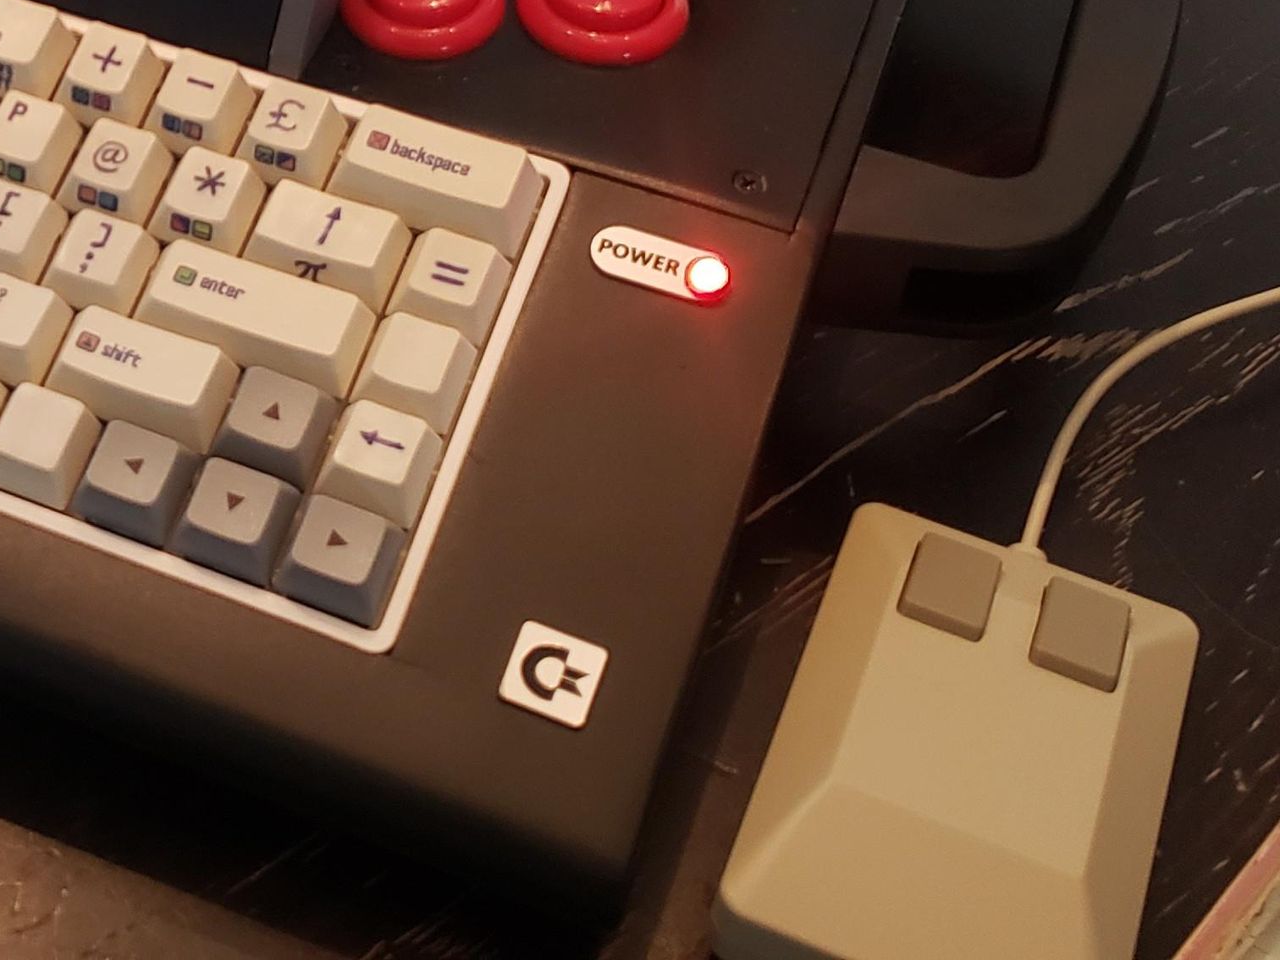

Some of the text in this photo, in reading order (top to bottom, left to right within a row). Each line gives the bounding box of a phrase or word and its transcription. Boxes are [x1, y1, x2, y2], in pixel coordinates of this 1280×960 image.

[8, 101, 28, 122] P
[265, 99, 305, 131] £
[92, 142, 129, 172] @
[389, 138, 472, 177] backspace
[597, 237, 681, 277] POWER
[198, 276, 246, 300] enter
[101, 342, 142, 369] shift
